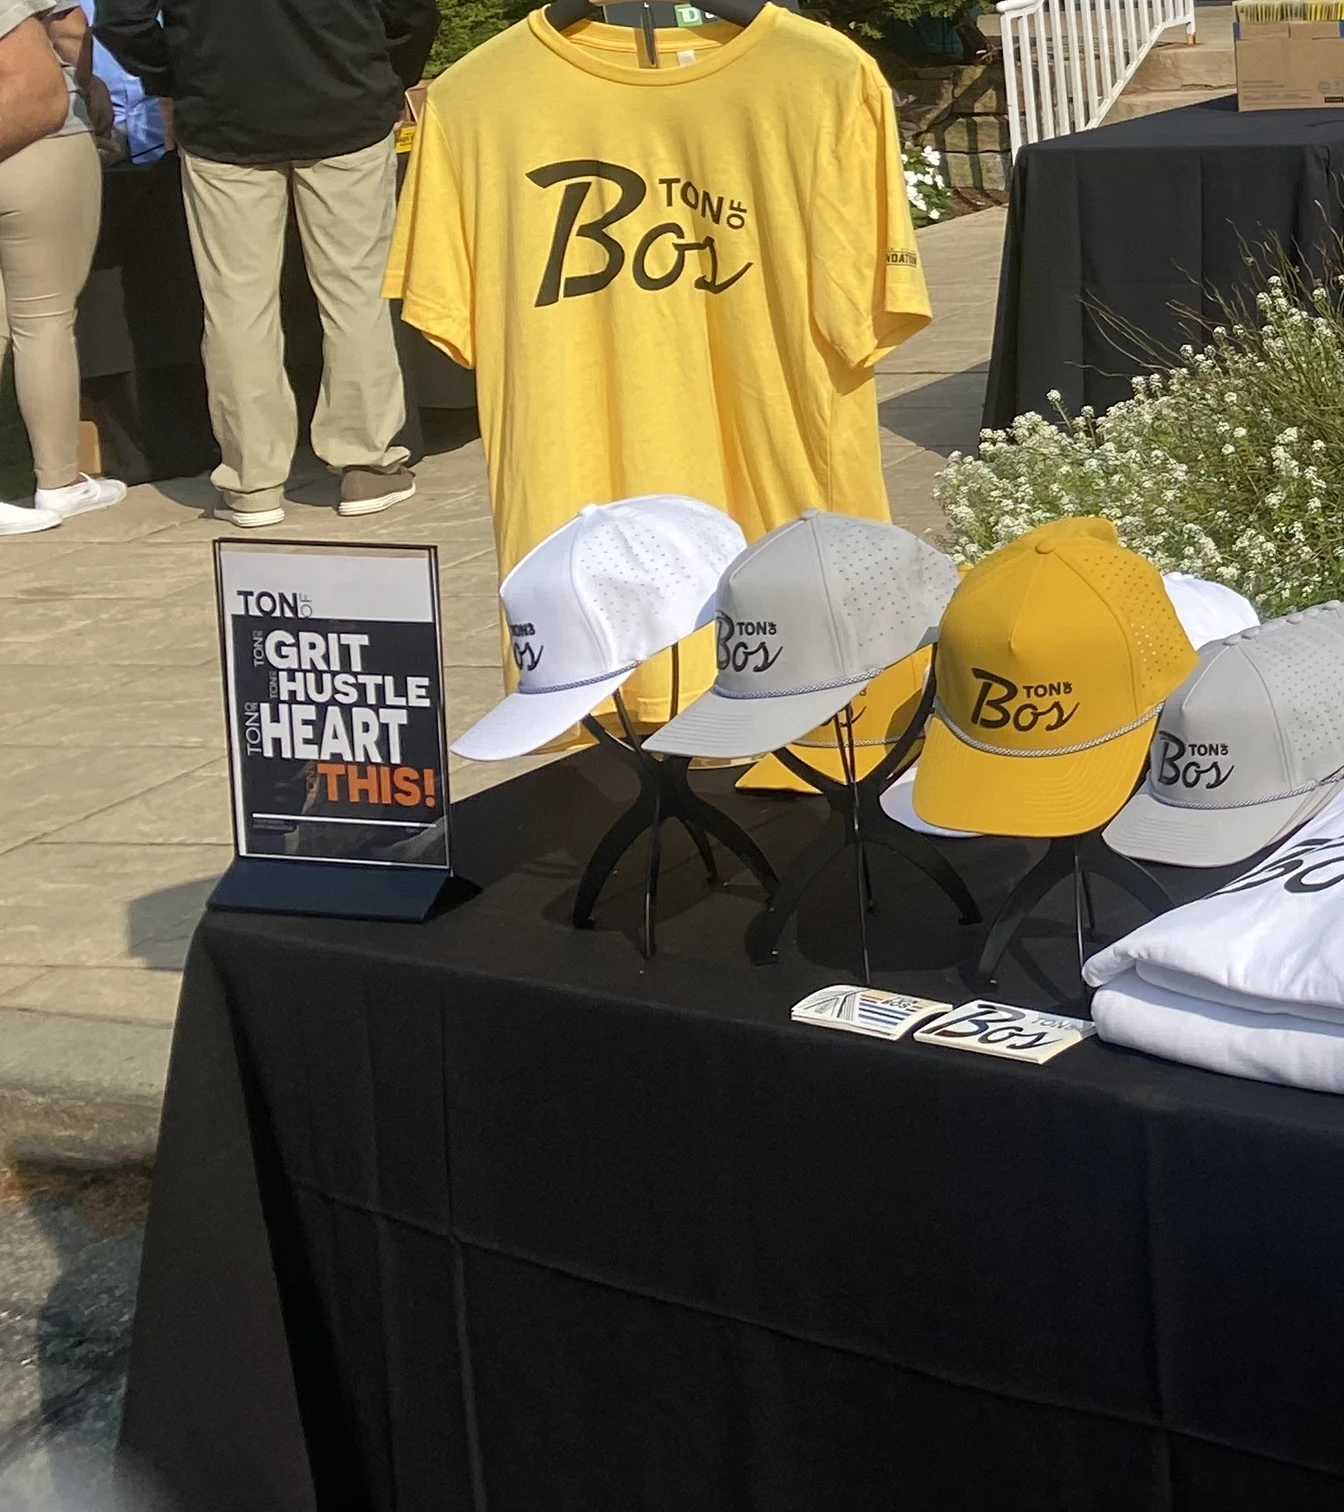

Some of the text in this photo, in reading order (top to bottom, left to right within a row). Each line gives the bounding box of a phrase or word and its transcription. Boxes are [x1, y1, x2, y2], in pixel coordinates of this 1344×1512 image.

[658, 178, 748, 230] TON OF
[525, 159, 754, 308] Bos
[236, 589, 312, 619] TON OF
[254, 629, 369, 672] TON GRIT
[716, 610, 783, 672] Bos
[736, 621, 767, 636] TON
[513, 641, 544, 671] os
[279, 671, 431, 707] HUSTLE
[971, 667, 1080, 732] Bos
[1022, 682, 1062, 698] TON
[245, 712, 262, 756] TON
[259, 703, 408, 764] HEART
[1188, 743, 1220, 757] TON
[1157, 730, 1235, 789] Bos
[317, 763, 435, 808] THIS!
[920, 1003, 1063, 1050] Bos
